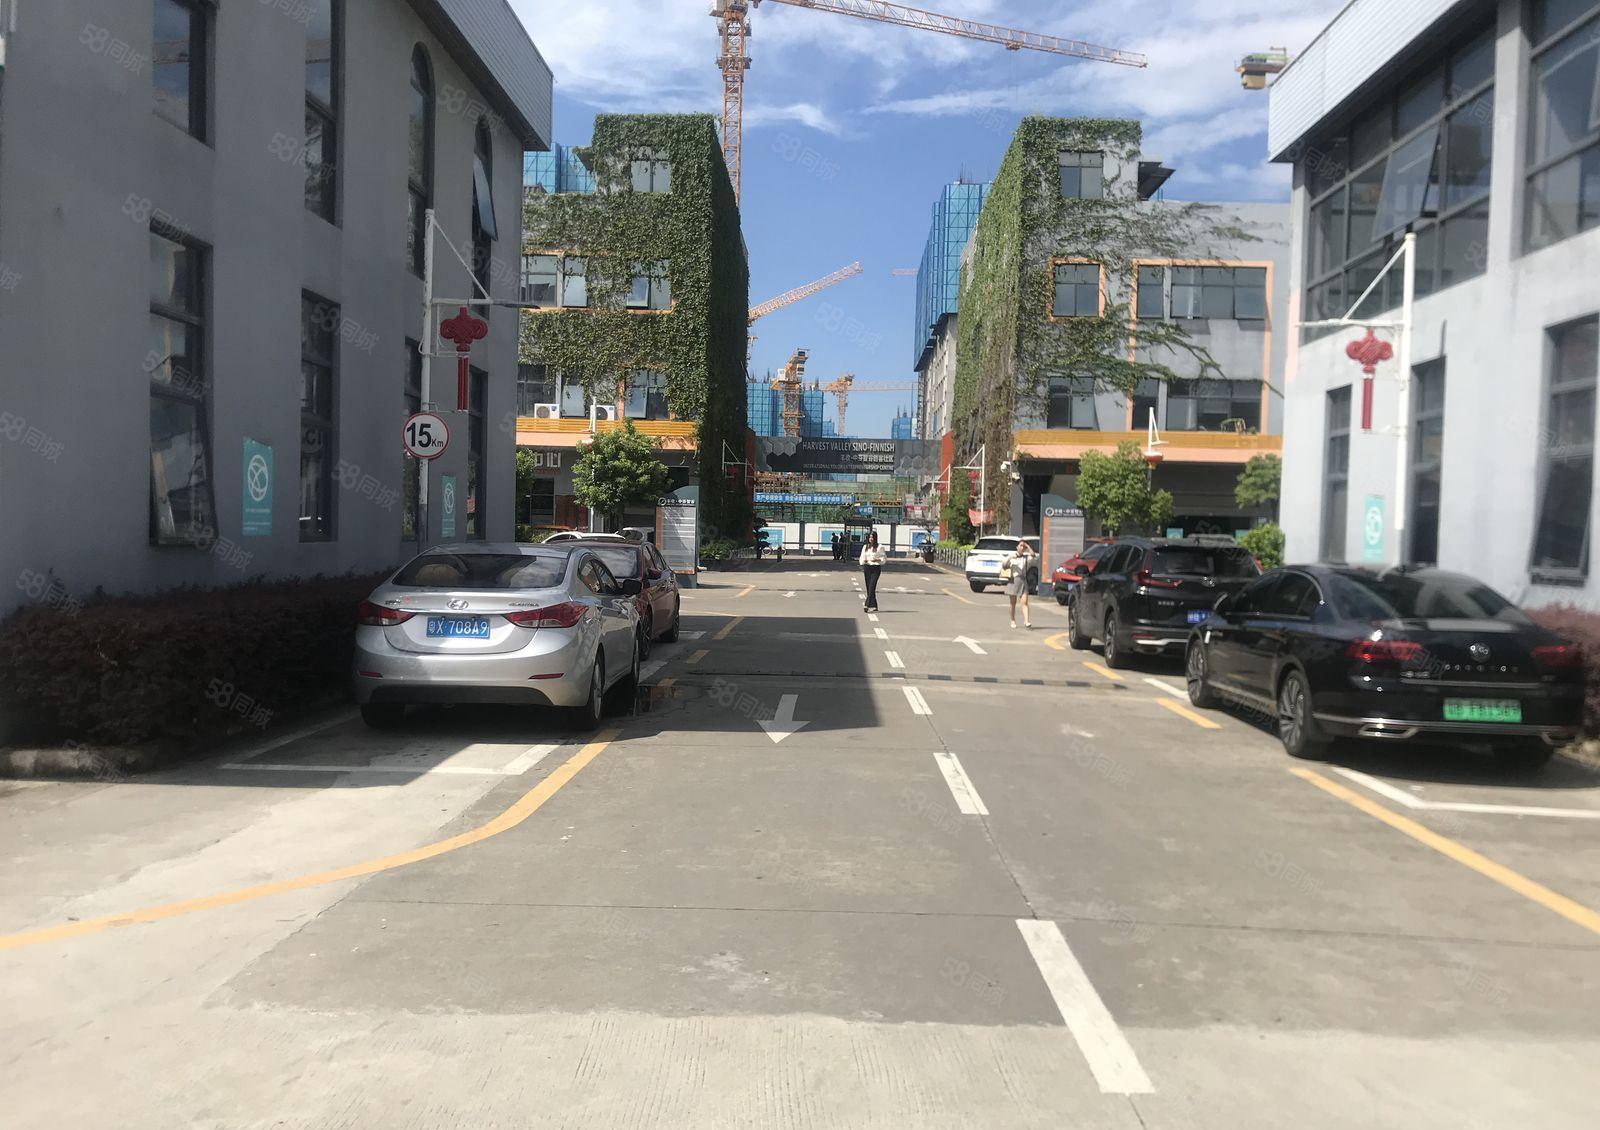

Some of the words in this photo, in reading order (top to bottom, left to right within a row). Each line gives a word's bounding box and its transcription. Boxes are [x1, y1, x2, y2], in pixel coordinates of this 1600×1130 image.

[802, 441, 829, 451] HARVEST
[831, 442, 852, 452] VALLEY
[852, 442, 895, 453] SINO-FINNISH
